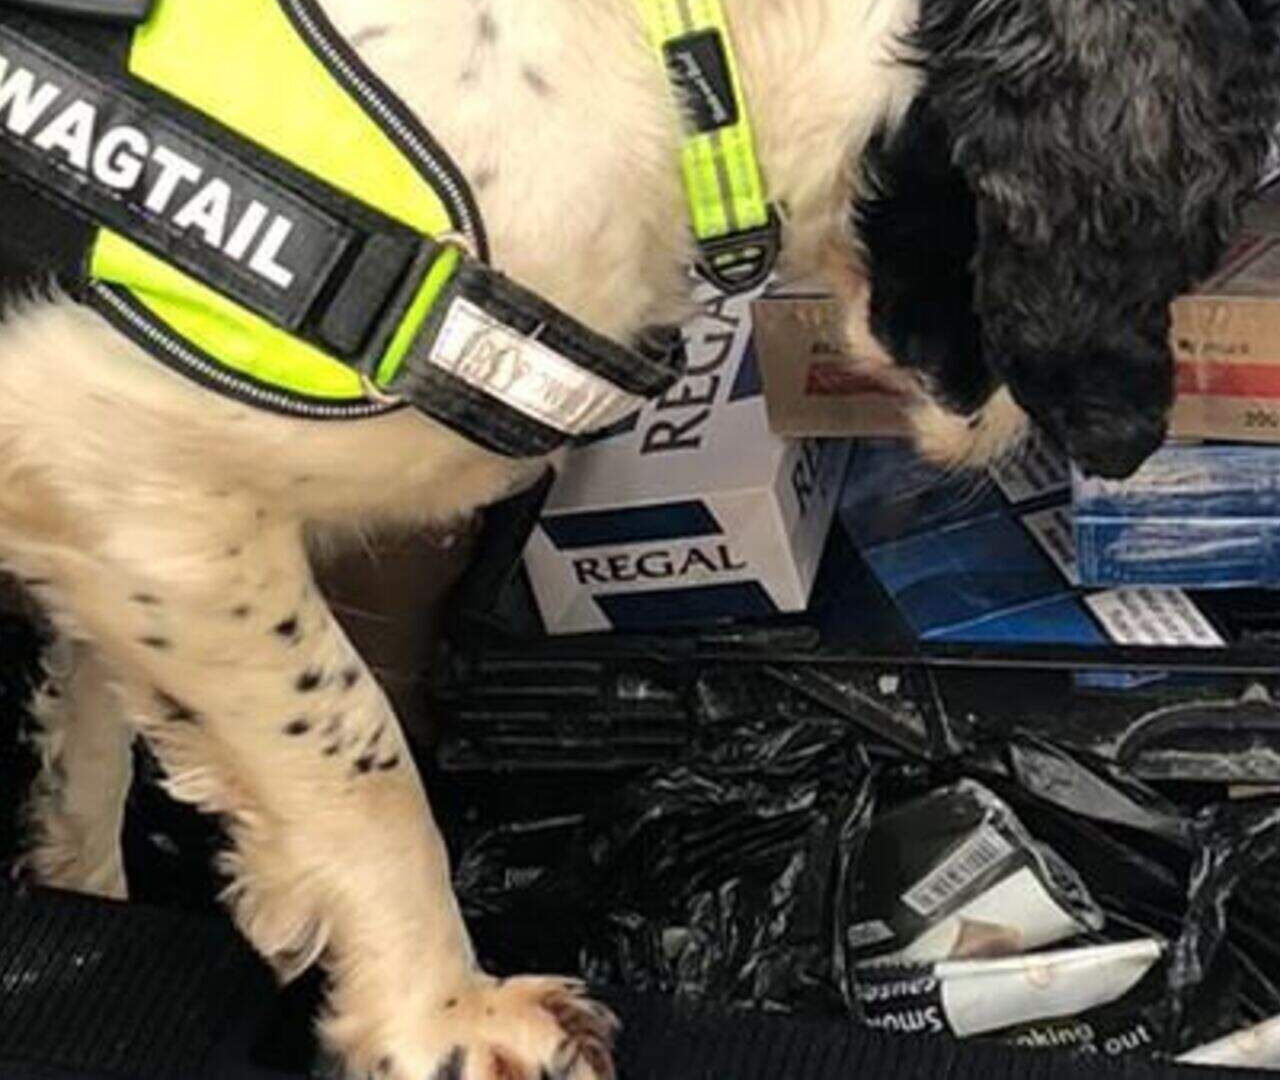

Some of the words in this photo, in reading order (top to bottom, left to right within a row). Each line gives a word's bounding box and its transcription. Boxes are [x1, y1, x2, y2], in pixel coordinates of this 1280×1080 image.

[639, 294, 740, 456] REGA
[572, 542, 748, 586] REGAL
[1105, 1024, 1152, 1056] out
